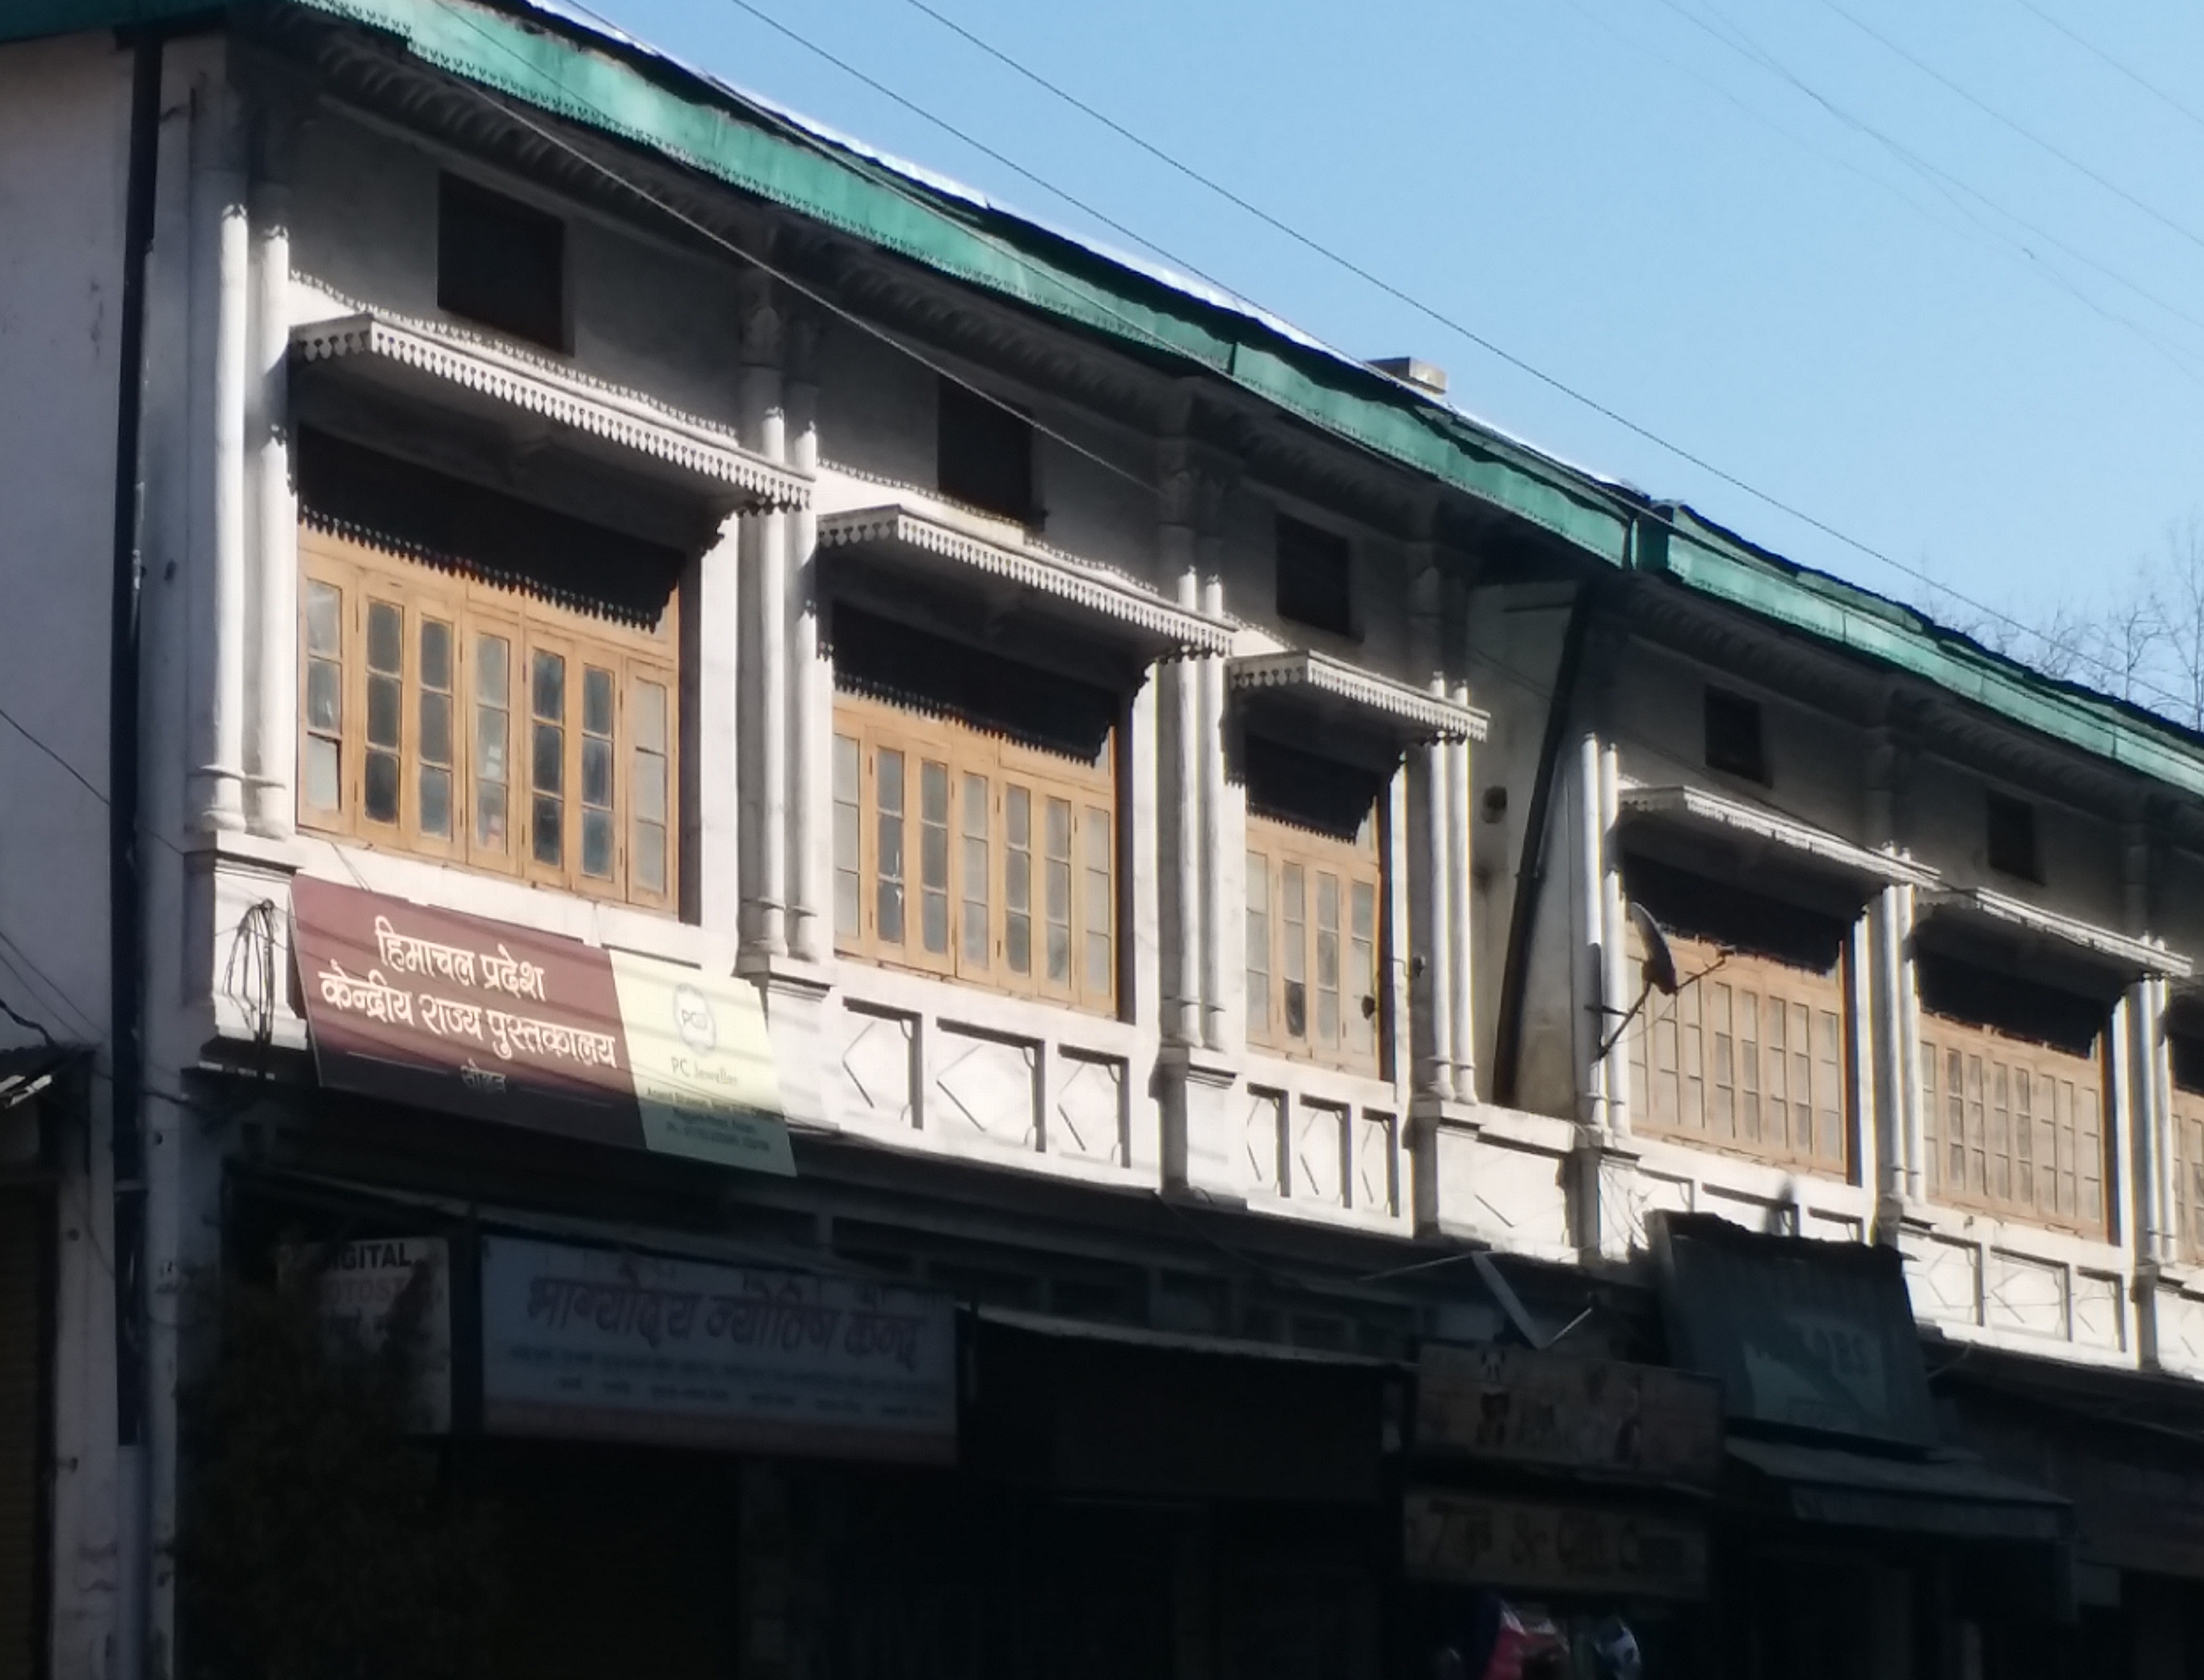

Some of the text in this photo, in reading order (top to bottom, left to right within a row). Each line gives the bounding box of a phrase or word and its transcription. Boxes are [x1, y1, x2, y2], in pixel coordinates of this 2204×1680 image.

[375, 916, 547, 1002] हिमाचल प्रदेश
[319, 959, 617, 1069] केन्द्रीय राज्य पुस्तकालय
[670, 1055, 691, 1077] PC
